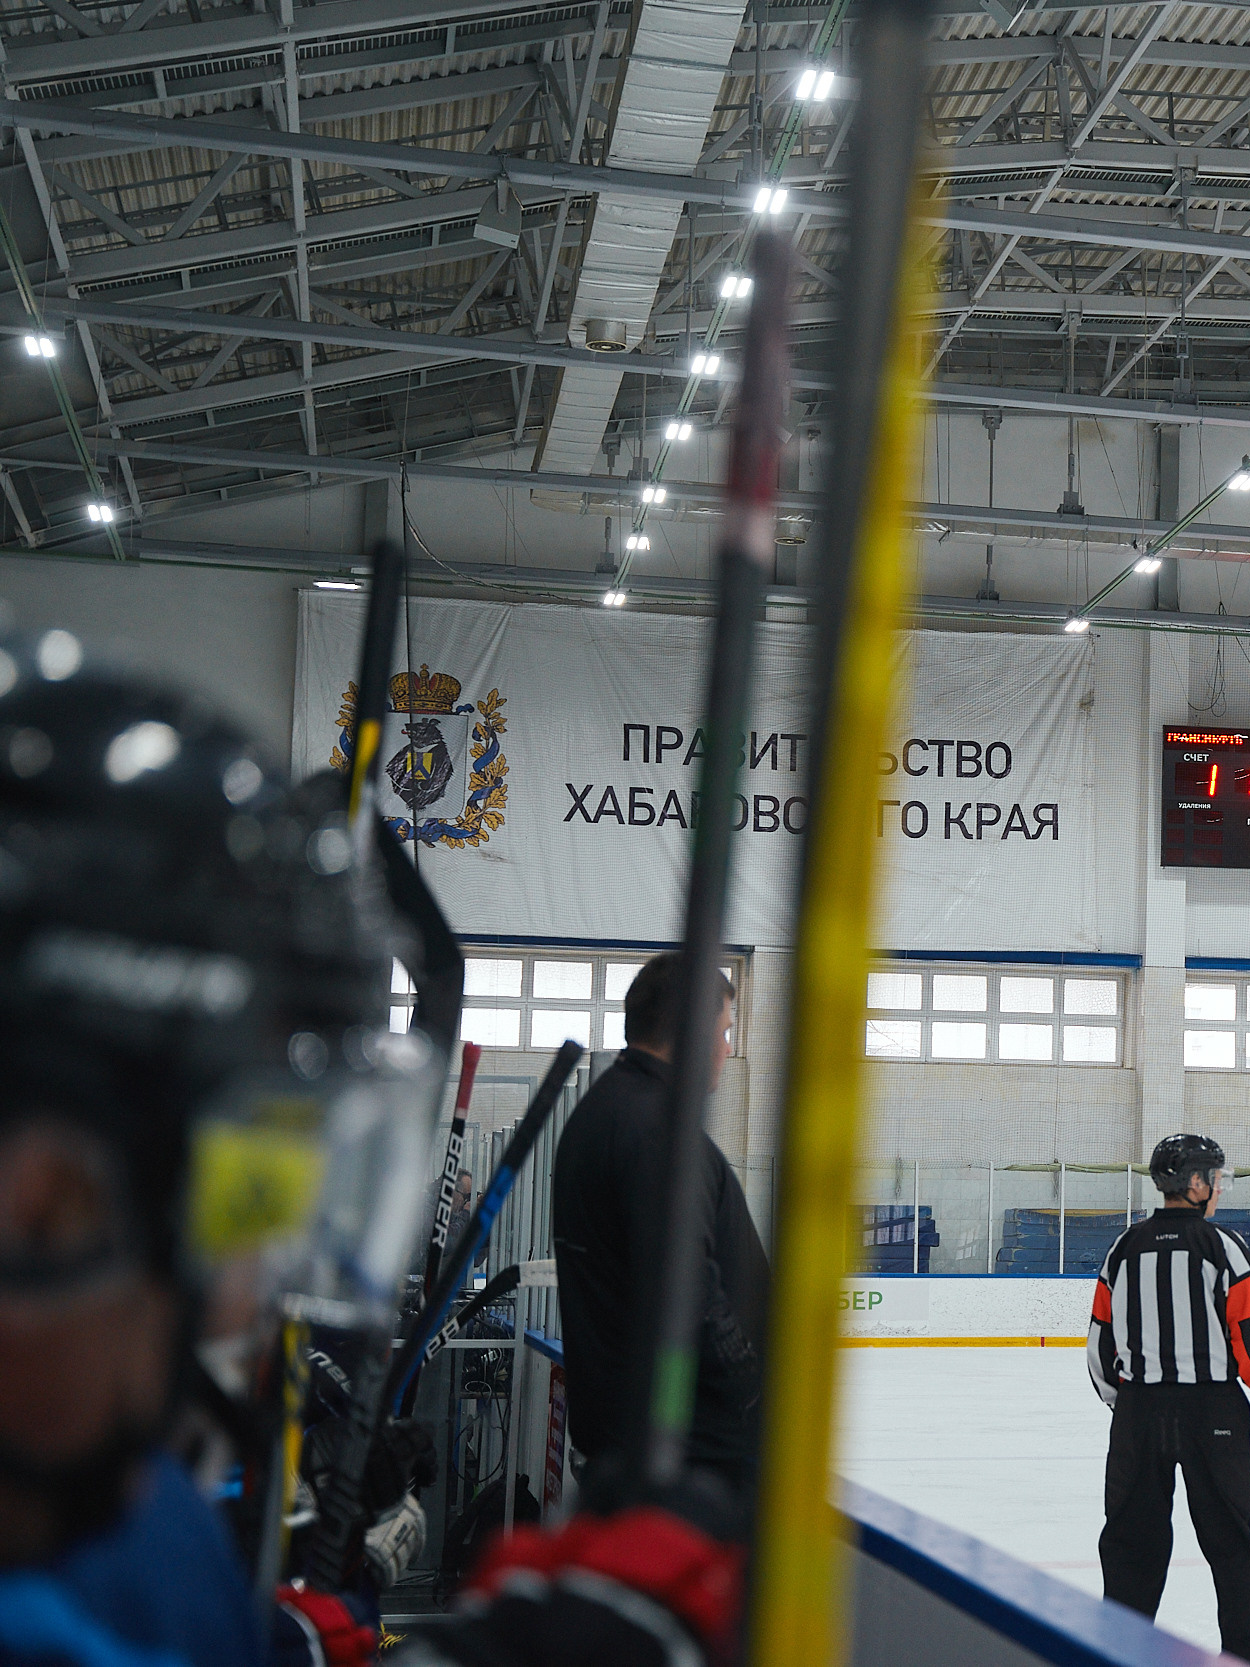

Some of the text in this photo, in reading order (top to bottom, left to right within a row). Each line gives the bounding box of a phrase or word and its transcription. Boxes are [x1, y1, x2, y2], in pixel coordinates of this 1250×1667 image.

[1183, 753, 1210, 763] СЧЕТ
[1209, 764, 1218, 796] 1
[1178, 802, 1211, 810] УДАЛЕНИЯ
[944, 801, 1060, 841] КРАЯ
[838, 1290, 883, 1311] БЕР
